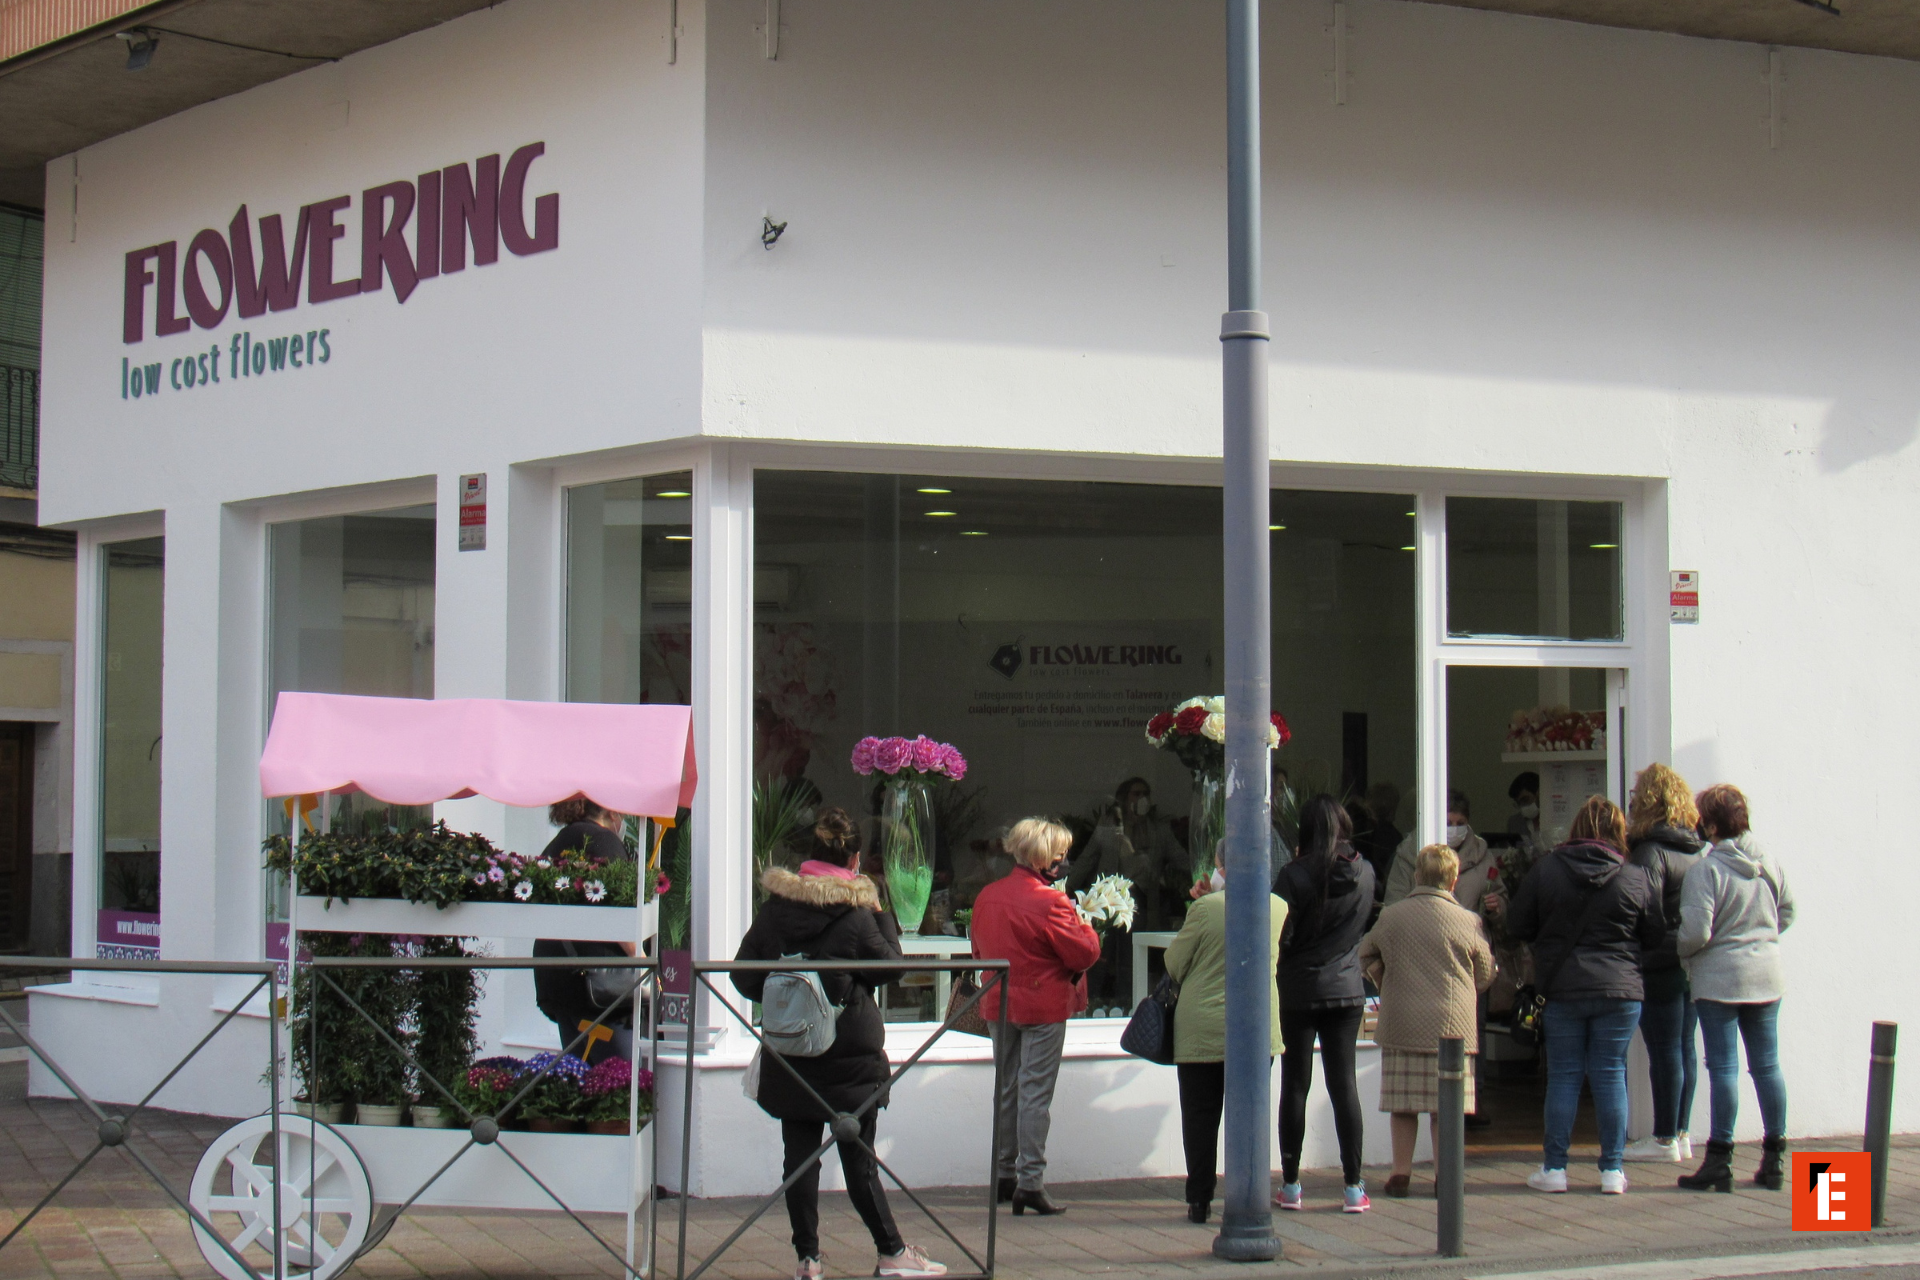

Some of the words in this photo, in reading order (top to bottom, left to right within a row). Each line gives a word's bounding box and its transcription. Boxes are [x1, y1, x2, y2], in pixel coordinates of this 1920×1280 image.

[123, 141, 559, 344] FLOWERING
[122, 357, 162, 399] low
[170, 344, 220, 390] cost
[230, 328, 331, 379] flowers
[461, 509, 486, 518] Alarma
[1029, 643, 1182, 667] FLOWERING
[1029, 666, 1045, 676] low
[1050, 666, 1069, 676] cost
[1073, 666, 1110, 676] flowers
[974, 690, 1022, 702] Entregamos
[1025, 691, 1034, 700] tu
[1036, 690, 1064, 702] pedido
[1073, 690, 1110, 700] domicilio
[1125, 690, 1162, 700] Talavera
[968, 704, 1009, 716] cualquier
[1012, 704, 1035, 716] parte
[1037, 704, 1048, 714] de
[1086, 704, 1113, 714] incluso
[1116, 706, 1126, 714] en
[1137, 704, 1164, 714] mismo
[1017, 718, 1052, 728] También
[1054, 718, 1080, 728] online
[1094, 717, 1147, 728] www.flowe
